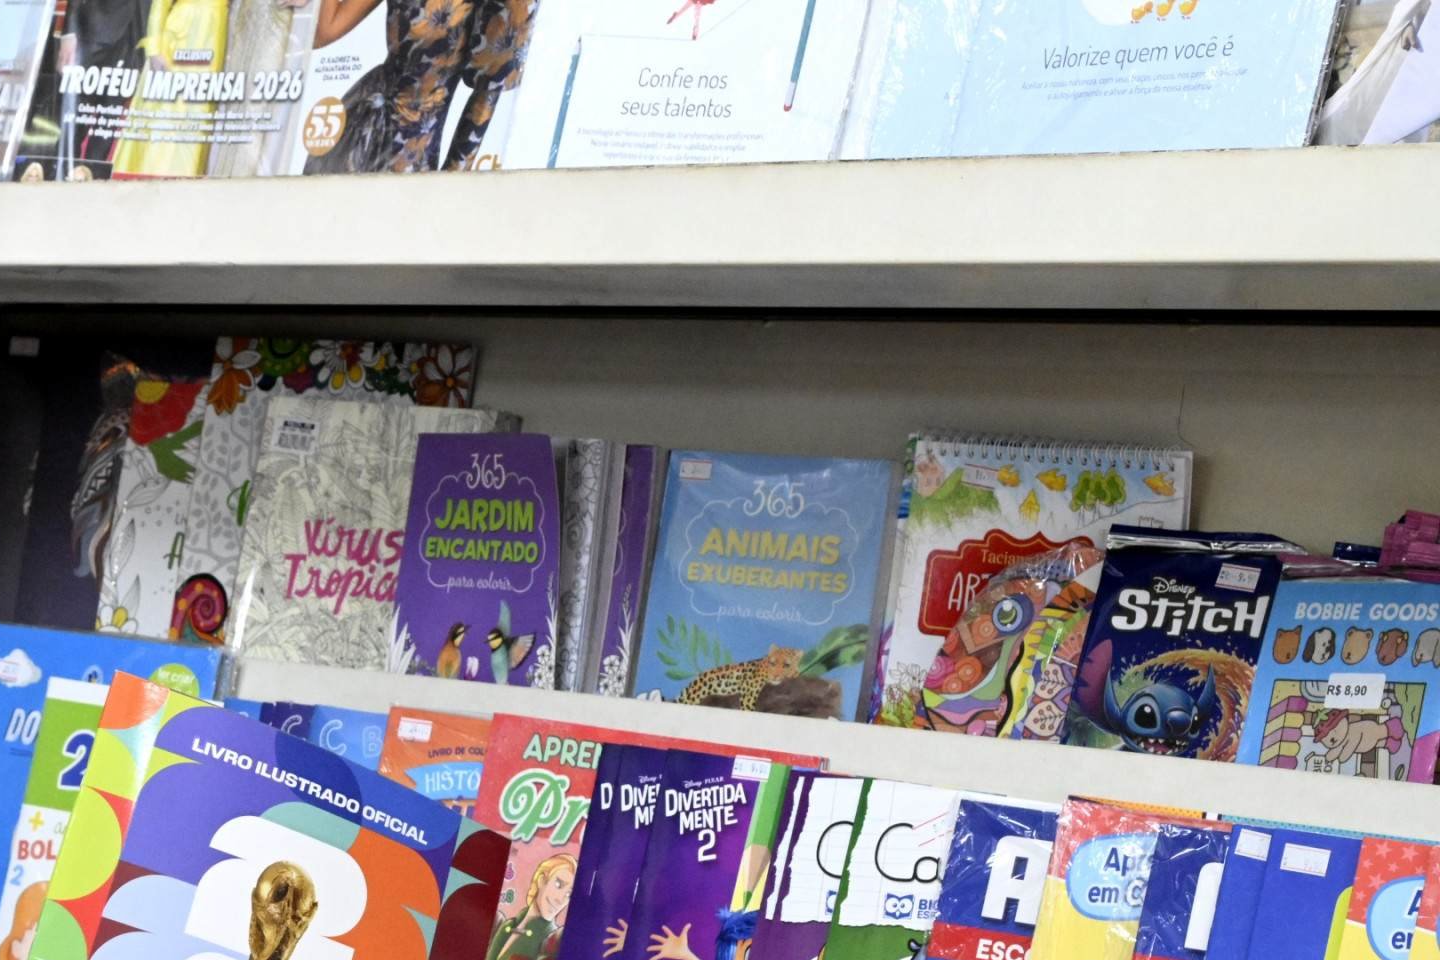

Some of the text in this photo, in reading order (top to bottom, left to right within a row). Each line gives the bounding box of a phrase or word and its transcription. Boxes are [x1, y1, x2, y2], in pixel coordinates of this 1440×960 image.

[1044, 35, 1234, 70] Valorize quem você é
[59, 60, 303, 101] TROFÉU IMPRENSA 2026
[638, 67, 728, 89] Confie nos
[306, 104, 345, 138] 55
[620, 97, 732, 118] seus talentos
[466, 453, 507, 490] 365
[434, 497, 535, 533] JARDIM
[743, 479, 805, 518] 365
[425, 536, 539, 565] ENCANTADO
[699, 527, 841, 565] ANIMAIS
[687, 561, 848, 594] EXUBERANTES
[1294, 601, 1440, 623] BOBBIE GOODS
[1326, 684, 1368, 697] R$ 8,90
[428, 748, 453, 759] LIVRO
[455, 747, 466, 756] DE
[191, 737, 428, 845] LIVRO ILUSTRADO OFICIAL
[665, 782, 747, 817] DIVERTIDA
[679, 804, 738, 835] MENTE
[697, 829, 717, 863] 2
[1088, 885, 1118, 904] em
